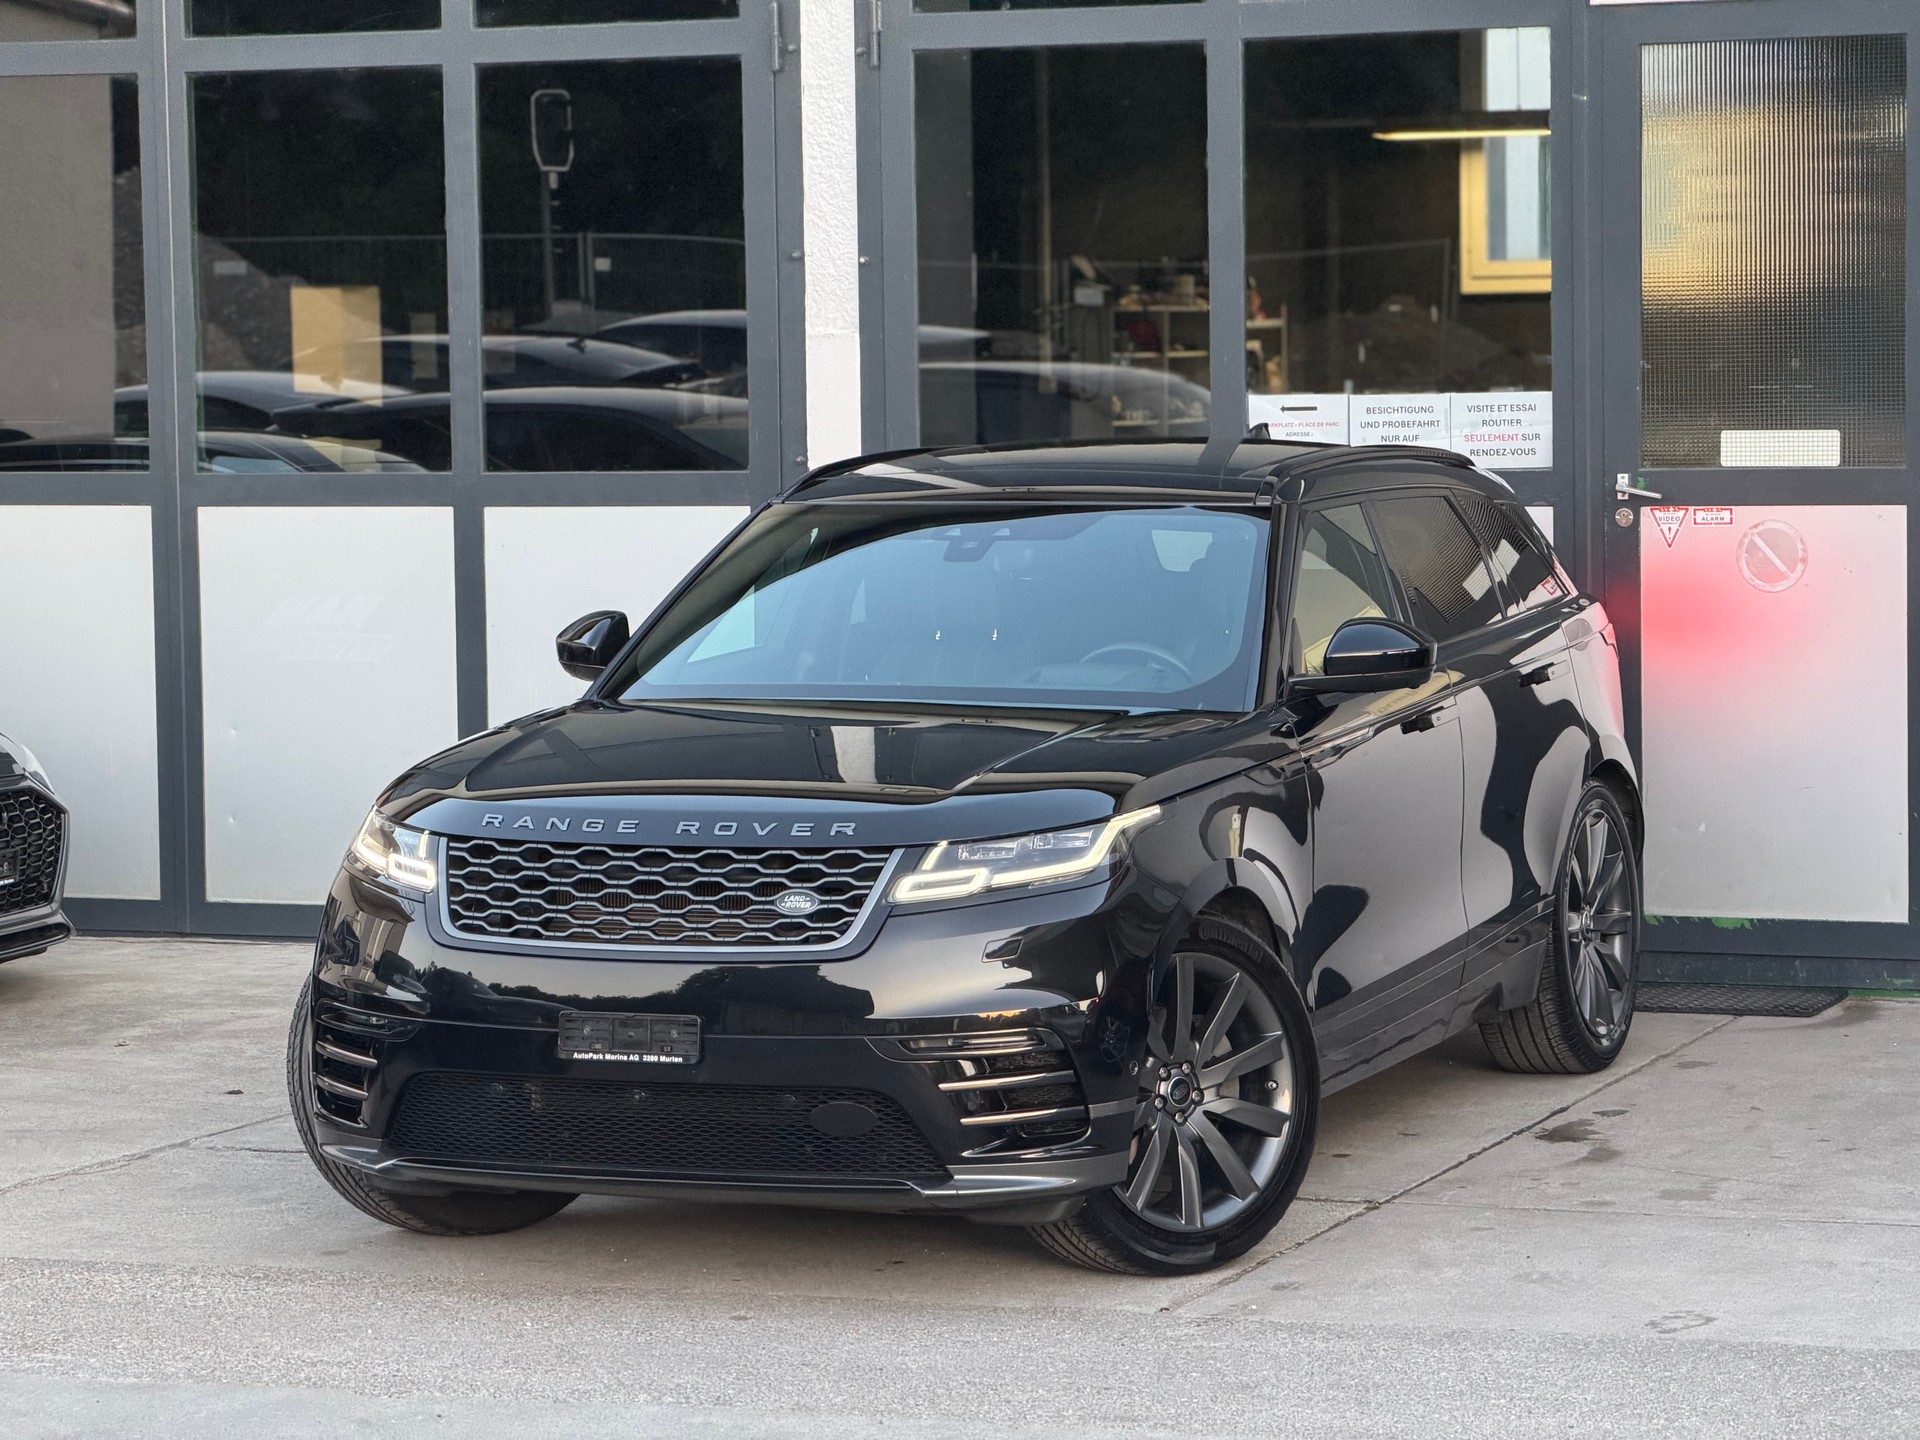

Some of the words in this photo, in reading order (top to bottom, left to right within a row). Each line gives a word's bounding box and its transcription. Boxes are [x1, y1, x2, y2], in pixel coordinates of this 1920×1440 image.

[1366, 405, 1434, 415] BESICHTIGUNG
[1466, 404, 1496, 413] VISITE
[1497, 404, 1508, 413] ET
[1510, 403, 1537, 412] ESSAI
[1359, 420, 1380, 429] UND
[1382, 419, 1441, 429] PROBEFAHRT
[1481, 418, 1522, 427] ROUTIER
[1380, 434, 1400, 443] NUR
[1402, 434, 1420, 443] AUF
[1463, 433, 1520, 443] SEULEMENT
[1521, 432, 1541, 442] SUR
[1469, 447, 1537, 457] RENDEZ-VOUS
[481, 812, 640, 834] RANGE
[675, 820, 857, 837] ROVER
[573, 1052, 604, 1060] AutoPark
[604, 1053, 628, 1061] Morina
[659, 1055, 683, 1063] Murten
